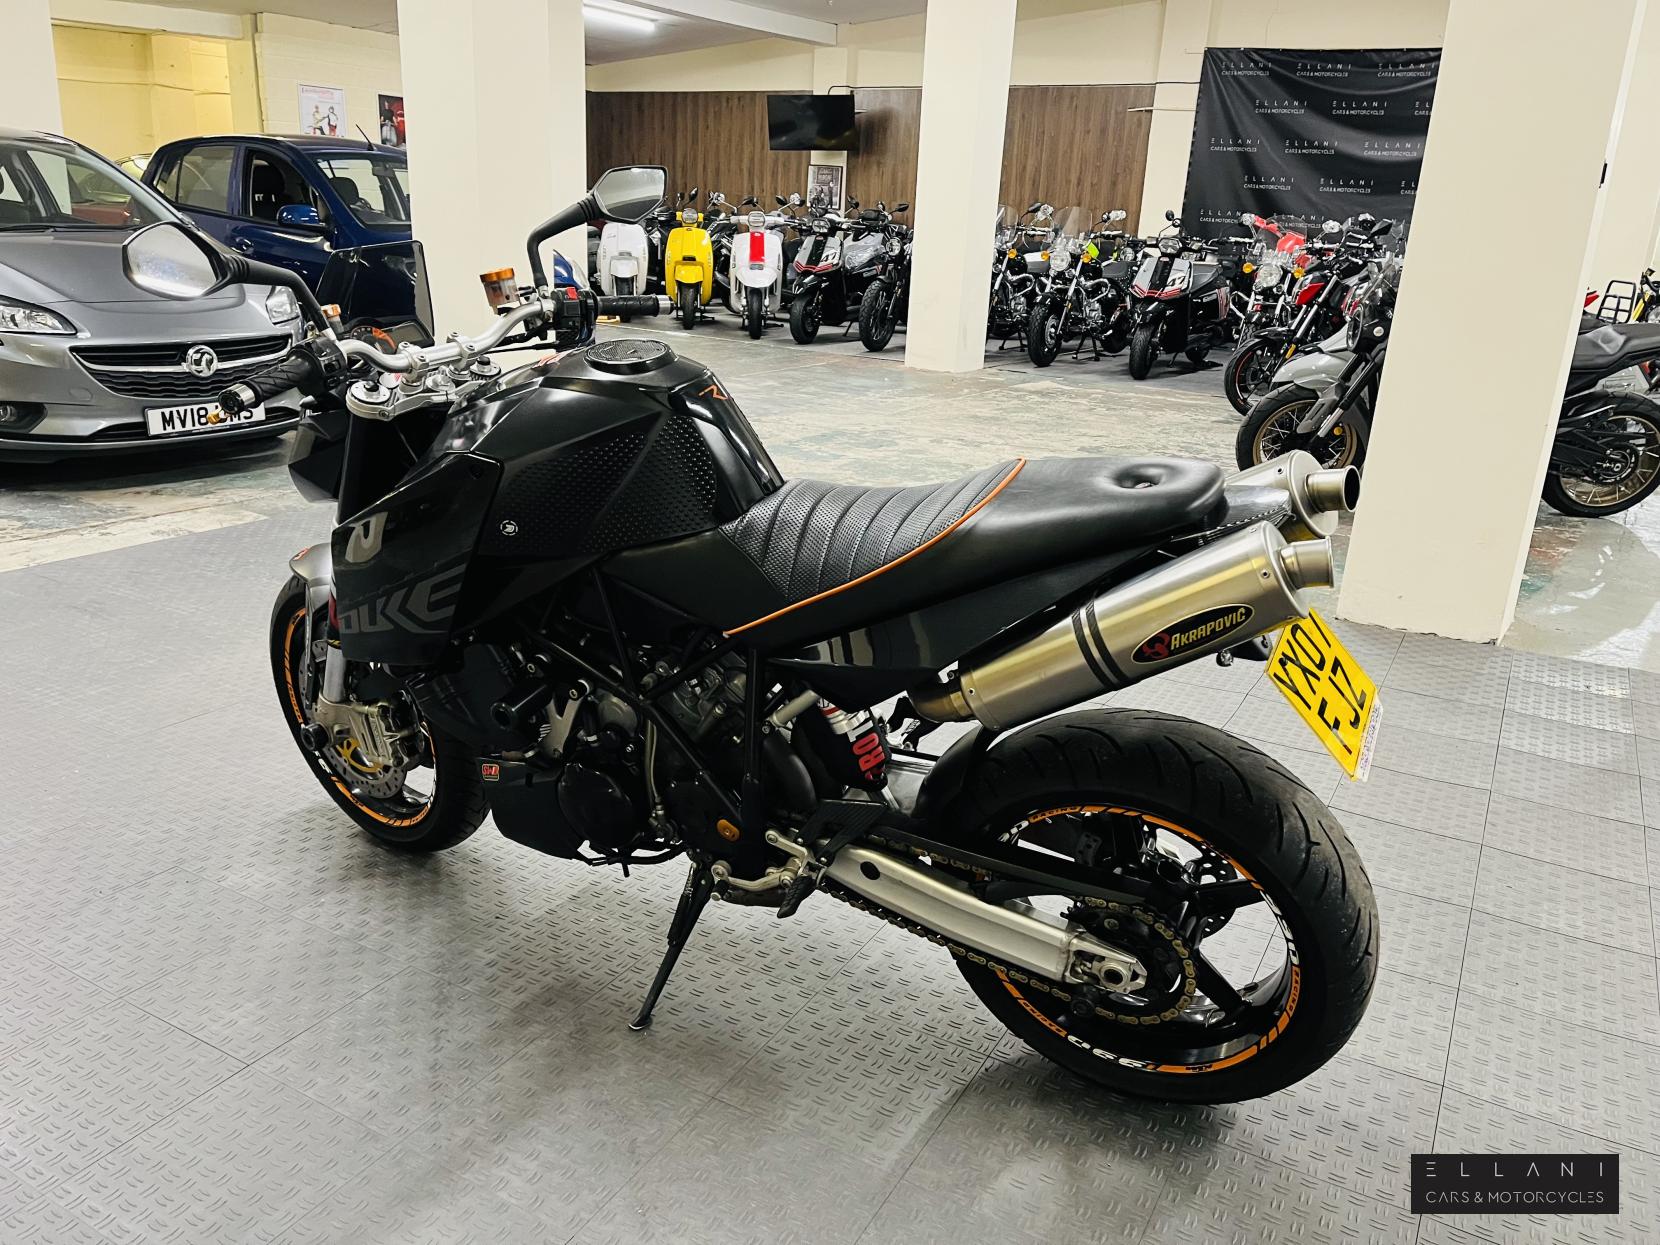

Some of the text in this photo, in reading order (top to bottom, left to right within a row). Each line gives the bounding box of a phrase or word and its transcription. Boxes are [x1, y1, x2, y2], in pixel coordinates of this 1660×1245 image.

[1332, 100, 1387, 108] ELLANI
[1210, 137, 1260, 145] ELLANI
[1285, 139, 1338, 147] ELLANI
[1364, 141, 1421, 149] ELLANI
[1244, 175, 1294, 183] ELLANI
[1320, 178, 1374, 186] ELLANI
[1200, 209, 1241, 217] ELLAN
[161, 407, 209, 431] MV18
